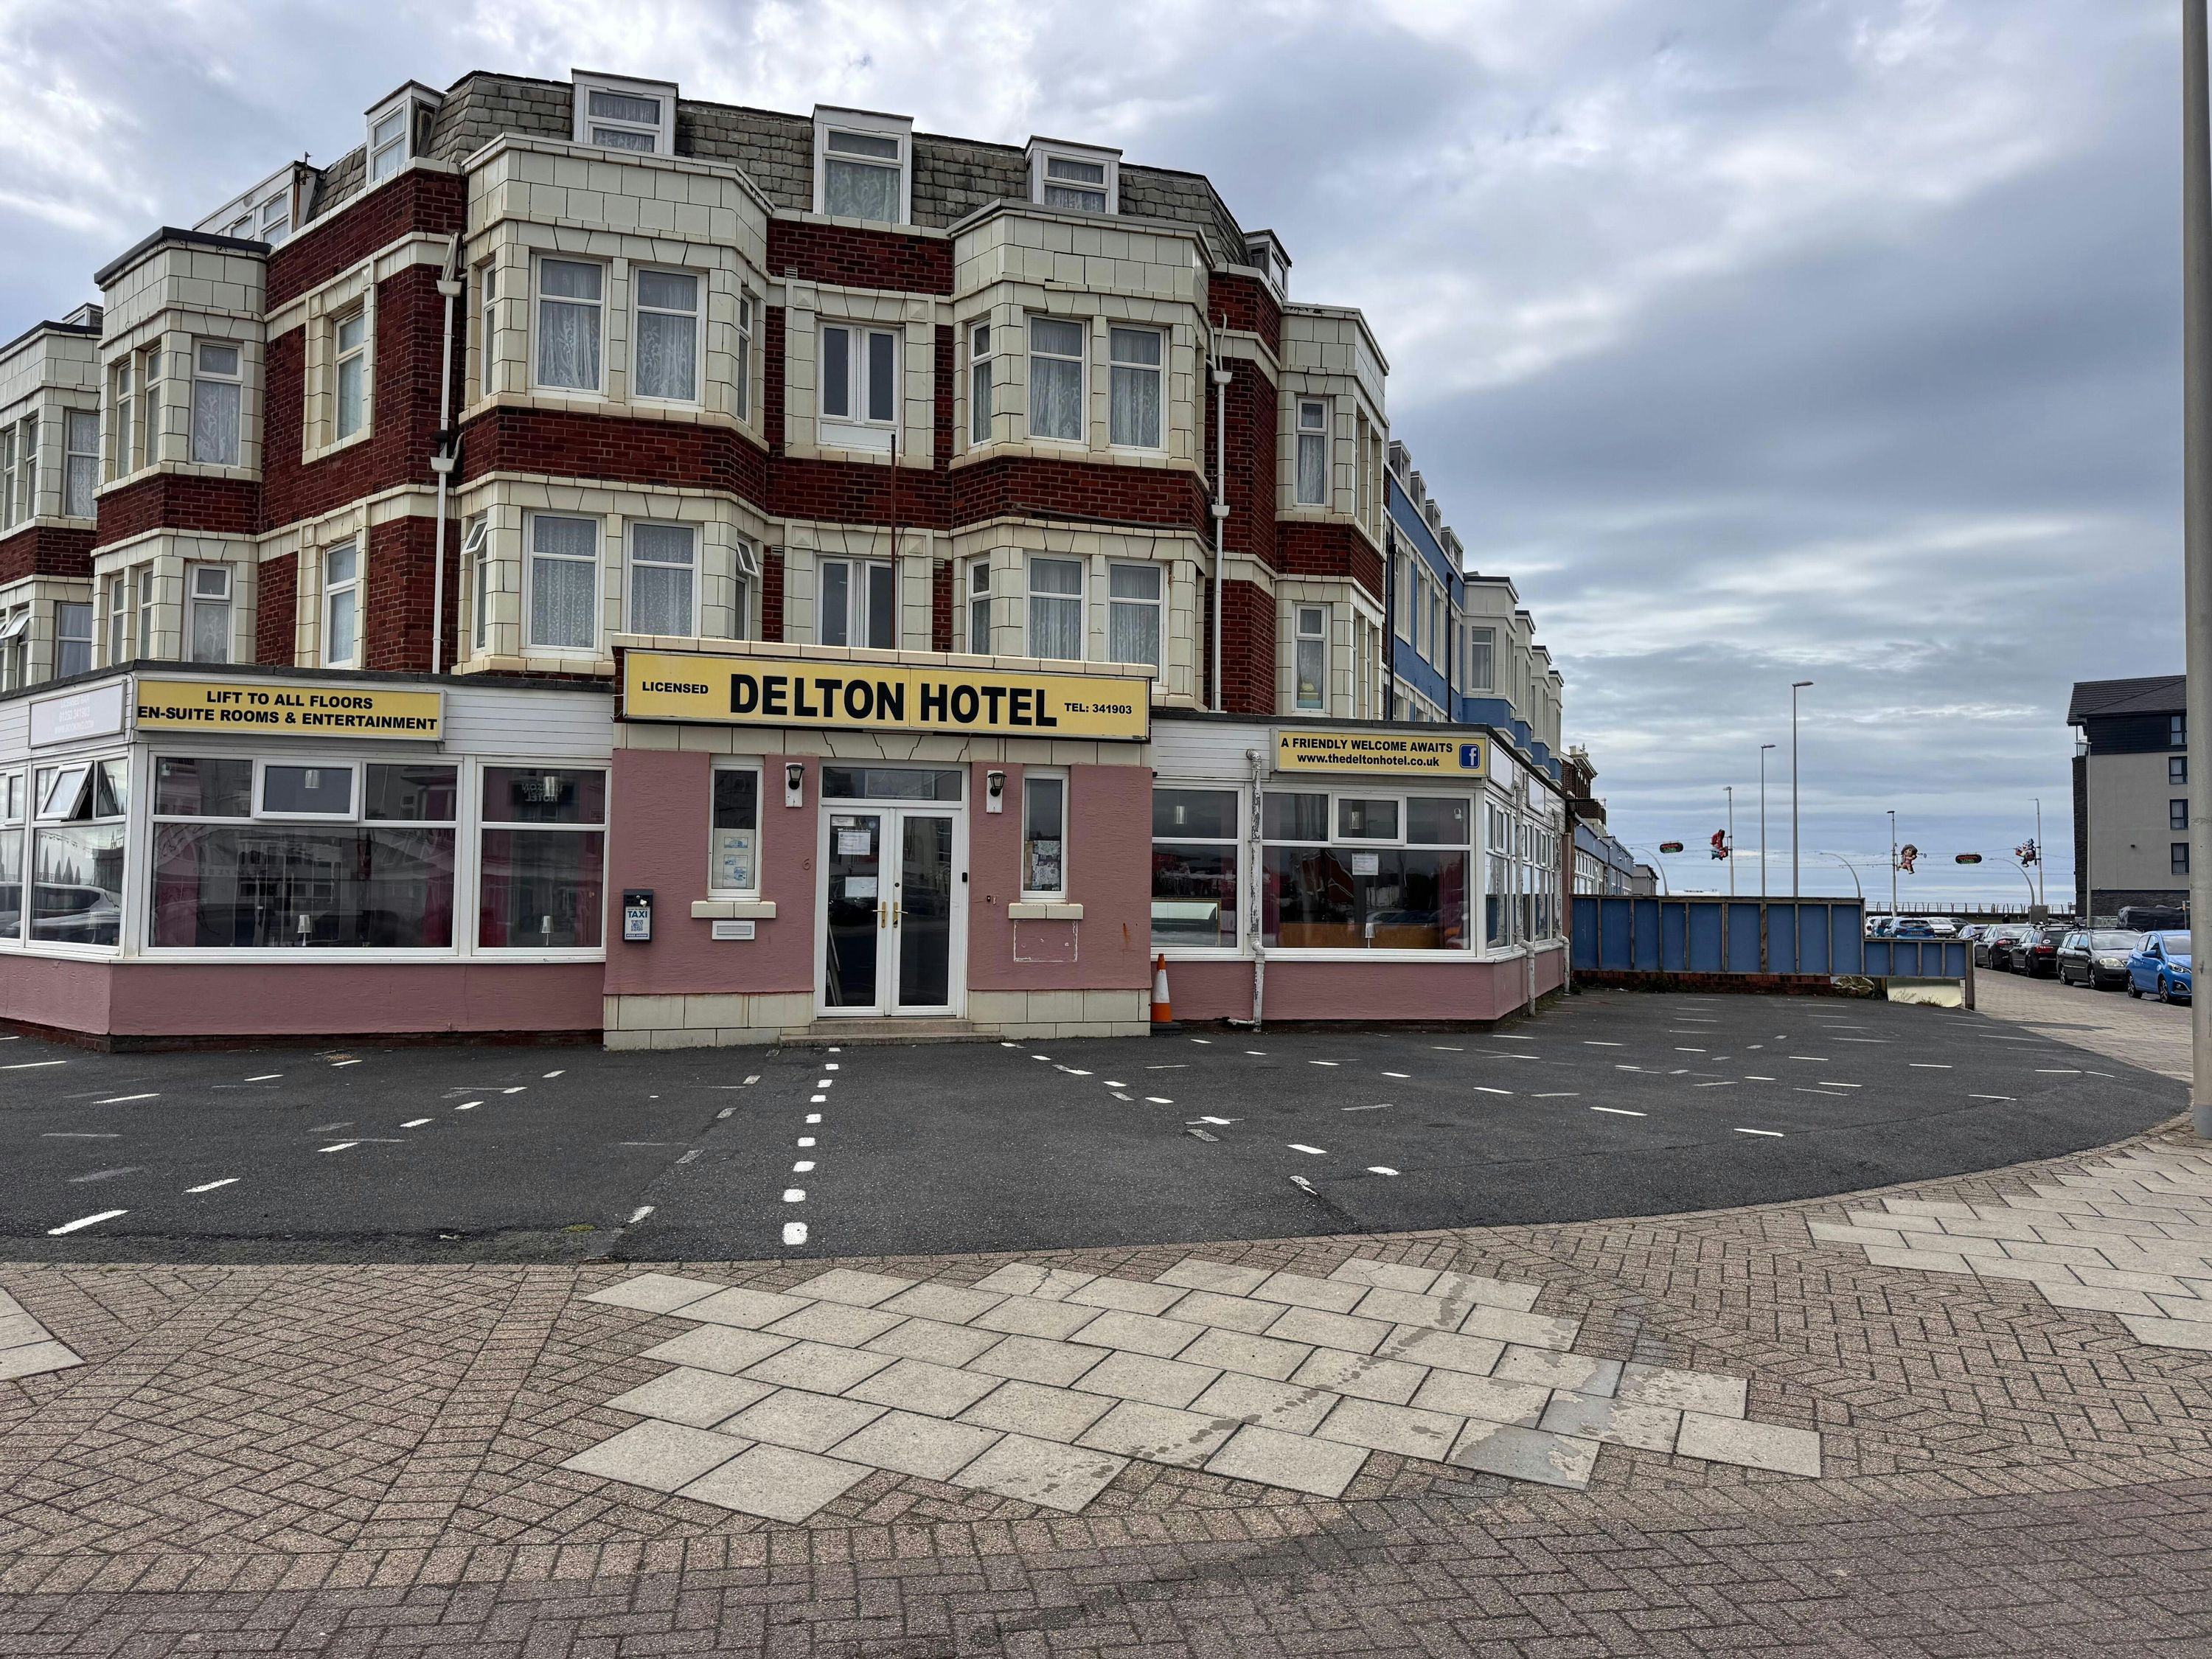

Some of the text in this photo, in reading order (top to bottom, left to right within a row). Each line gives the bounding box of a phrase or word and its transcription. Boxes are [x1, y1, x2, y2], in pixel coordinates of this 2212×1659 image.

[642, 681, 709, 694] LICENSED
[206, 691, 372, 709] LIFT TO ALL FLOORS
[731, 673, 1057, 726] DELTON HOTEL
[1064, 703, 1133, 714] TEL: 341903
[138, 706, 437, 730] EN-SUITE ROOMS & ENTERTAINMENT
[1281, 737, 1453, 753] A FRIENDLY WELCOME AWAITS
[1297, 754, 1440, 767] www.thedeltonhotel.co.uk
